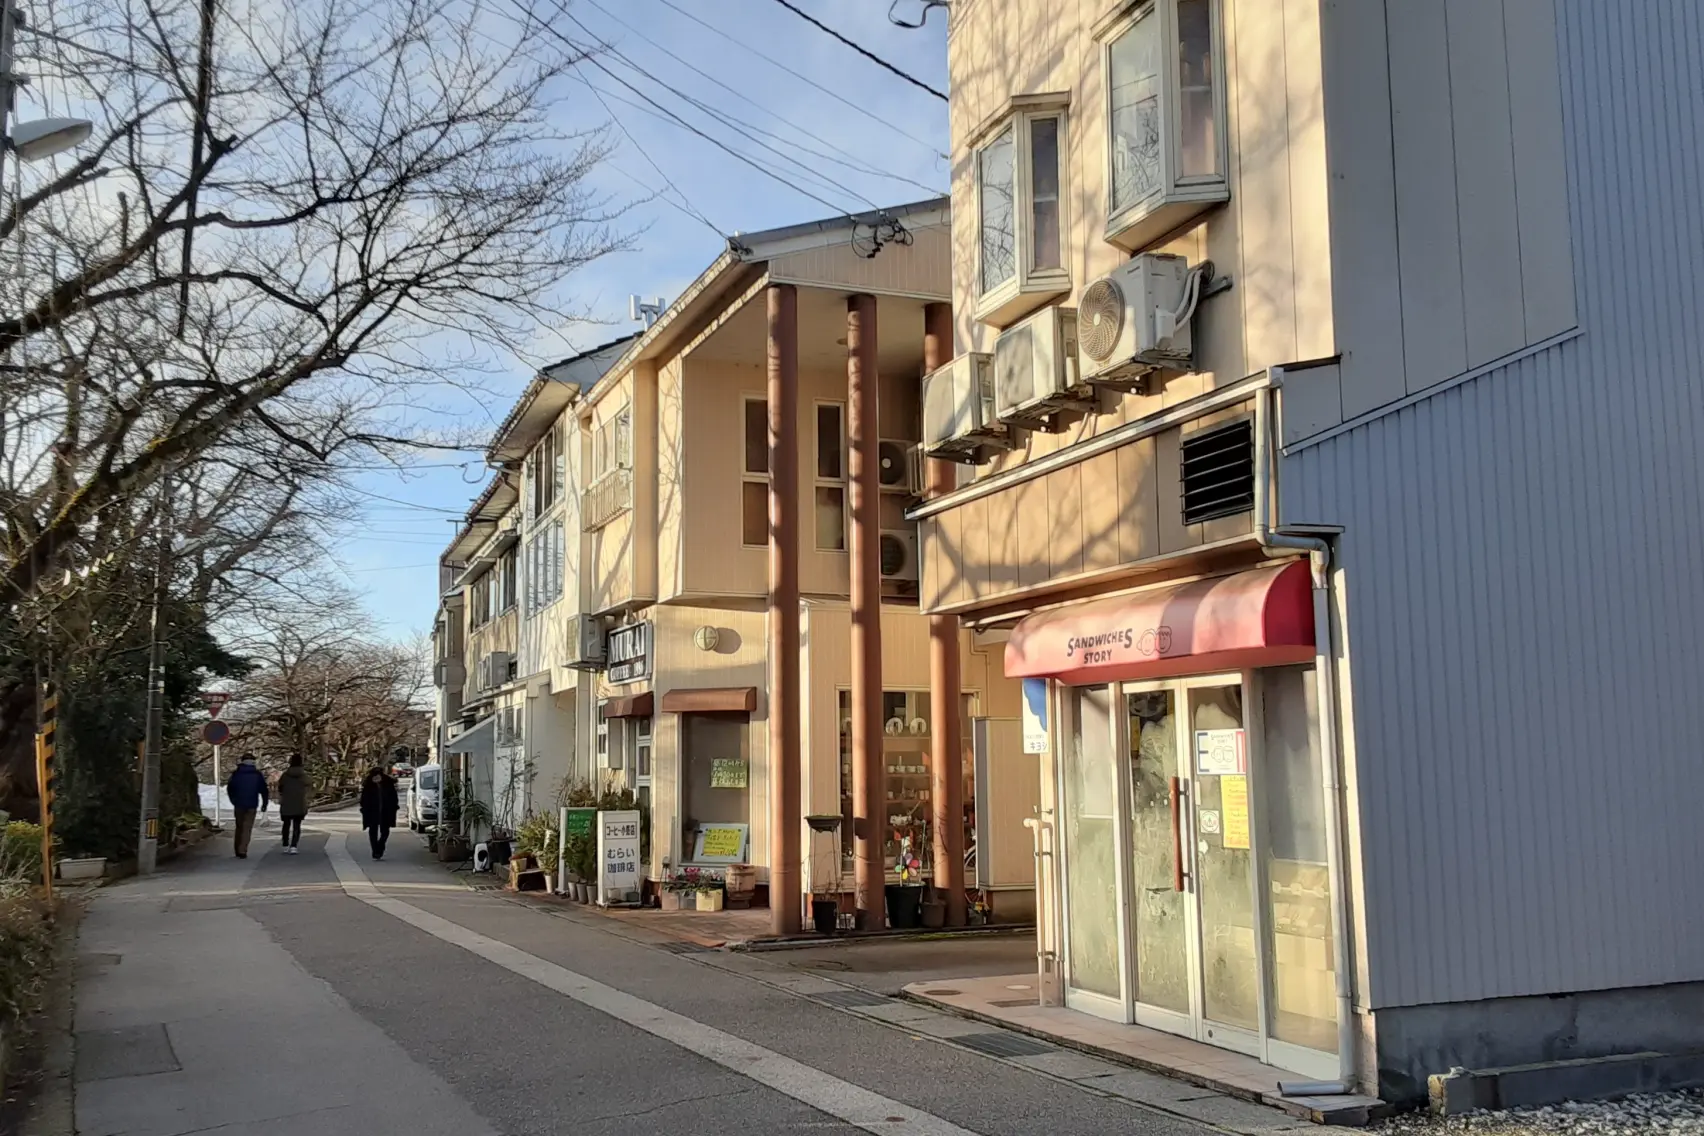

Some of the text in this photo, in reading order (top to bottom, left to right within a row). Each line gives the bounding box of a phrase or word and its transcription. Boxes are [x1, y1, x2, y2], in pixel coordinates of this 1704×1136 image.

[610, 625, 645, 664] MURAI
[1067, 628, 1133, 657] SANDWICHES
[1083, 649, 1112, 664] STORY
[610, 664, 630, 681] COFFEE
[607, 847, 635, 859] むらい
[607, 861, 635, 873] 珈琲店
